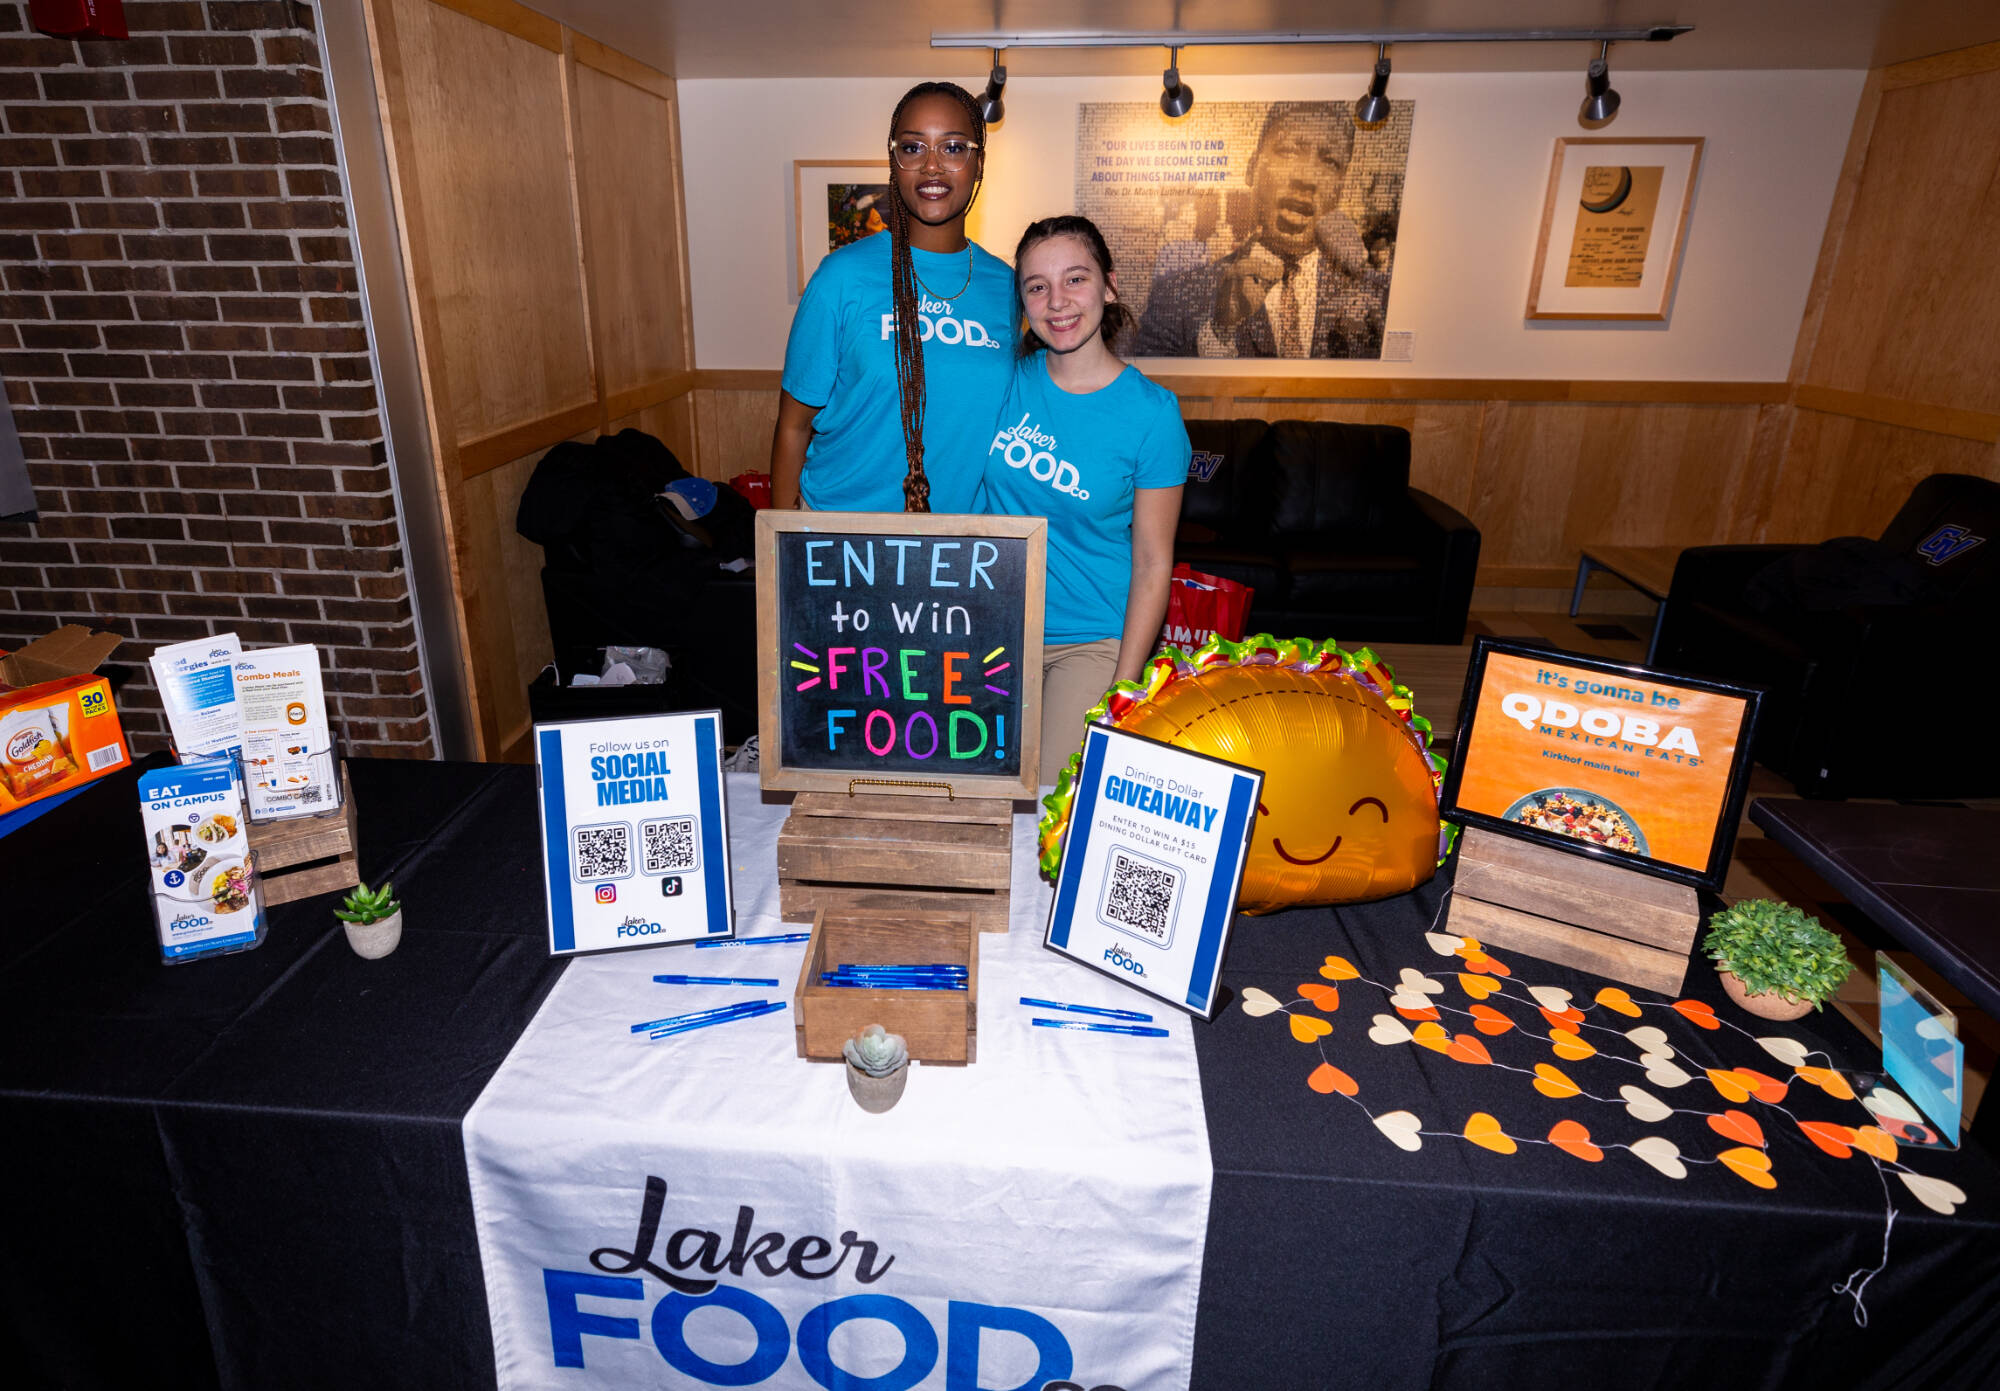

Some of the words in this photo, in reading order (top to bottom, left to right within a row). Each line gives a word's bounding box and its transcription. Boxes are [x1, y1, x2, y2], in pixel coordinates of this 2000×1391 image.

[1129, 140, 1157, 150] LIVES
[1159, 140, 1187, 150] BEGIN
[1190, 140, 1202, 150] TO
[1204, 140, 1225, 150] END
[1096, 156, 1113, 167] THE
[1116, 156, 1134, 166] DAY
[1136, 156, 1152, 166] WE
[1154, 156, 1193, 166] BECOME
[1196, 156, 1228, 166] SILENT
[1091, 172, 1123, 182] ABOUT
[1126, 172, 1160, 182] THINGS
[1163, 172, 1186, 181] THAT
[1008, 413, 1058, 451] Laker
[806, 539, 999, 590] ENTER
[831, 601, 870, 633] to
[237, 673, 271, 682] Combo
[273, 670, 301, 679] Meals
[828, 647, 972, 704] FREE
[1536, 669, 1568, 687] it's
[1574, 678, 1645, 704] gonna
[1651, 691, 1681, 710] be
[82, 691, 103, 707] 30
[86, 705, 107, 715] PACKS
[827, 709, 1005, 760] FOOD!
[1501, 693, 1700, 756] QDOBA
[1540, 726, 1634, 752] MEXICAN
[11, 732, 44, 758] Goldfish
[589, 742, 631, 754] Follow
[635, 741, 650, 750] us
[653, 738, 669, 749] on
[590, 751, 671, 781] SOCIAL
[1542, 750, 1582, 765] Kirkhof
[1584, 757, 1611, 771] main
[1613, 765, 1640, 778] level
[148, 784, 182, 799] EAT
[597, 777, 668, 807] MEDIA
[1125, 765, 1164, 790] Dining
[1167, 779, 1204, 800] Dollar
[151, 801, 171, 811] ON
[174, 793, 226, 808] CAMPUS
[1105, 775, 1219, 833] GIVEAWAY
[1099, 820, 1127, 836] DINING
[1129, 831, 1160, 847] DOLLAR
[1163, 844, 1182, 854] GIFT
[1184, 851, 1207, 864] CARD
[1113, 815, 1137, 829] ENTER
[1140, 824, 1151, 834] TO
[1153, 829, 1170, 840] WIN
[1181, 839, 1196, 850] $15
[621, 915, 645, 927] Laker
[589, 1175, 895, 1295] Laker
